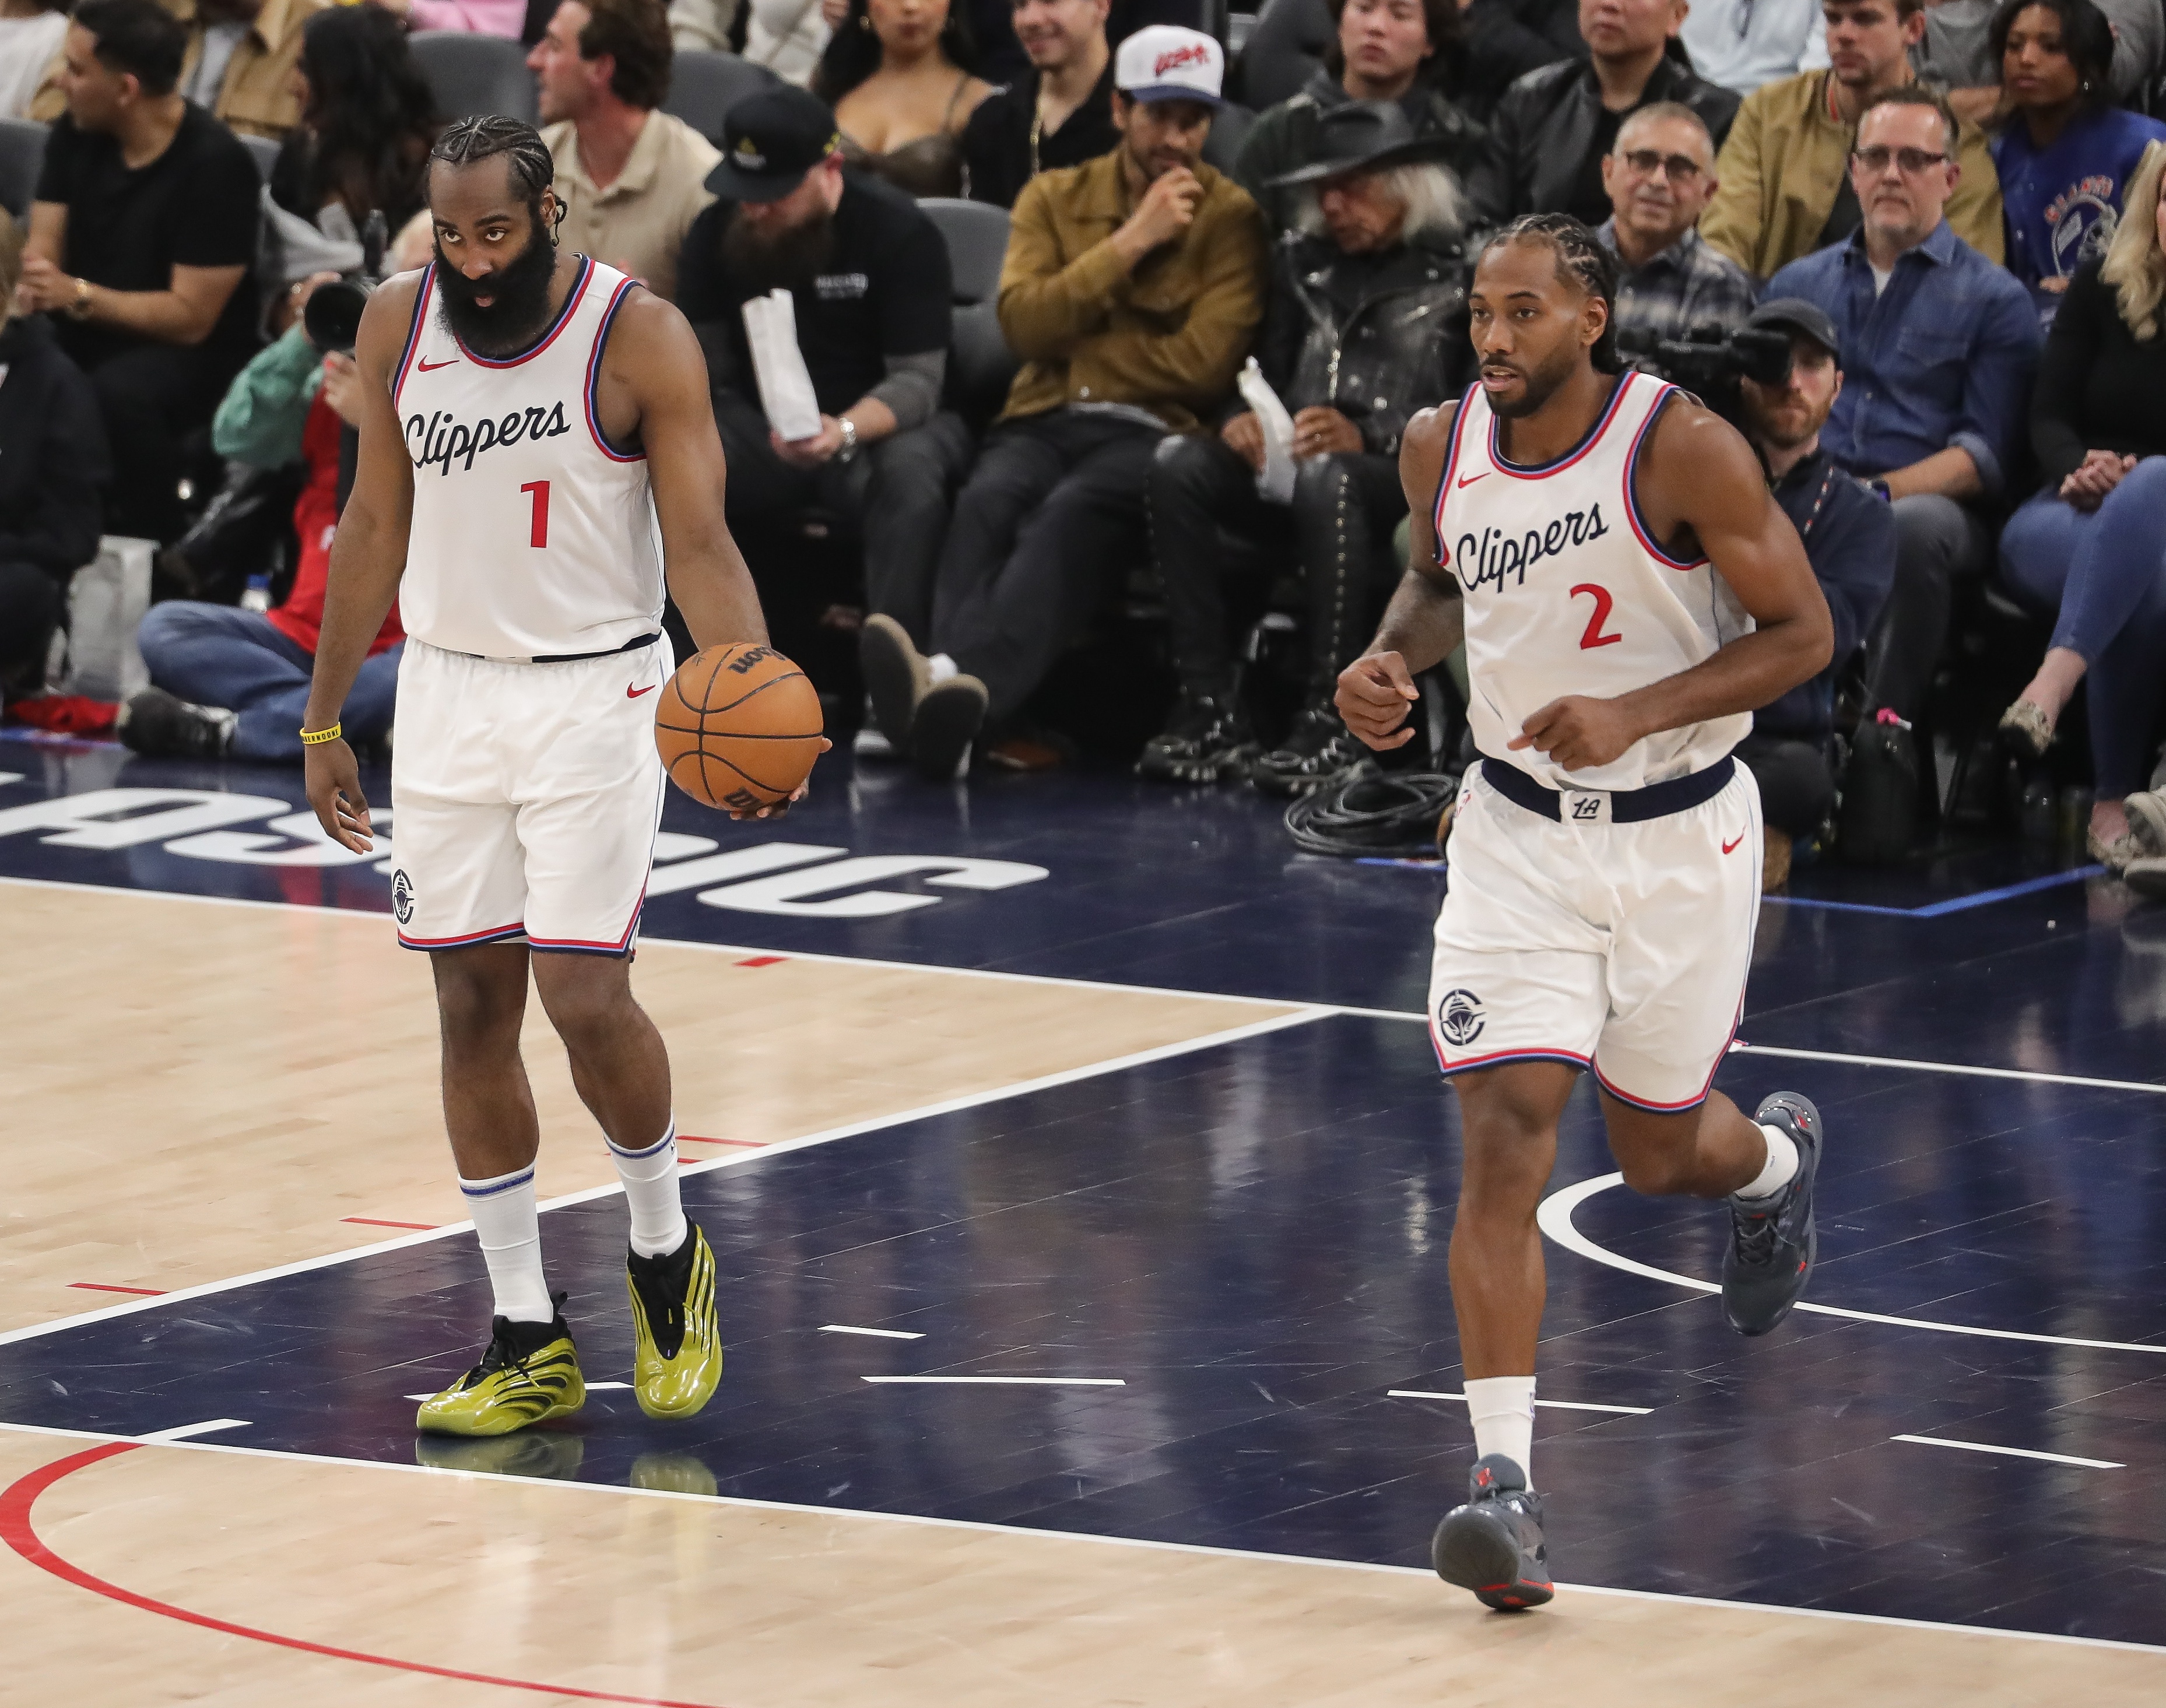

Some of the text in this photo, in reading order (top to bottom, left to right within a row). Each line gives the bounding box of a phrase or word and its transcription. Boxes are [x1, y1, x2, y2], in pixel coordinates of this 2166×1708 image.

[406, 400, 571, 477] Clippers
[521, 480, 550, 549] 1
[1457, 501, 1609, 593] Clippers
[1570, 583, 1622, 650] 2
